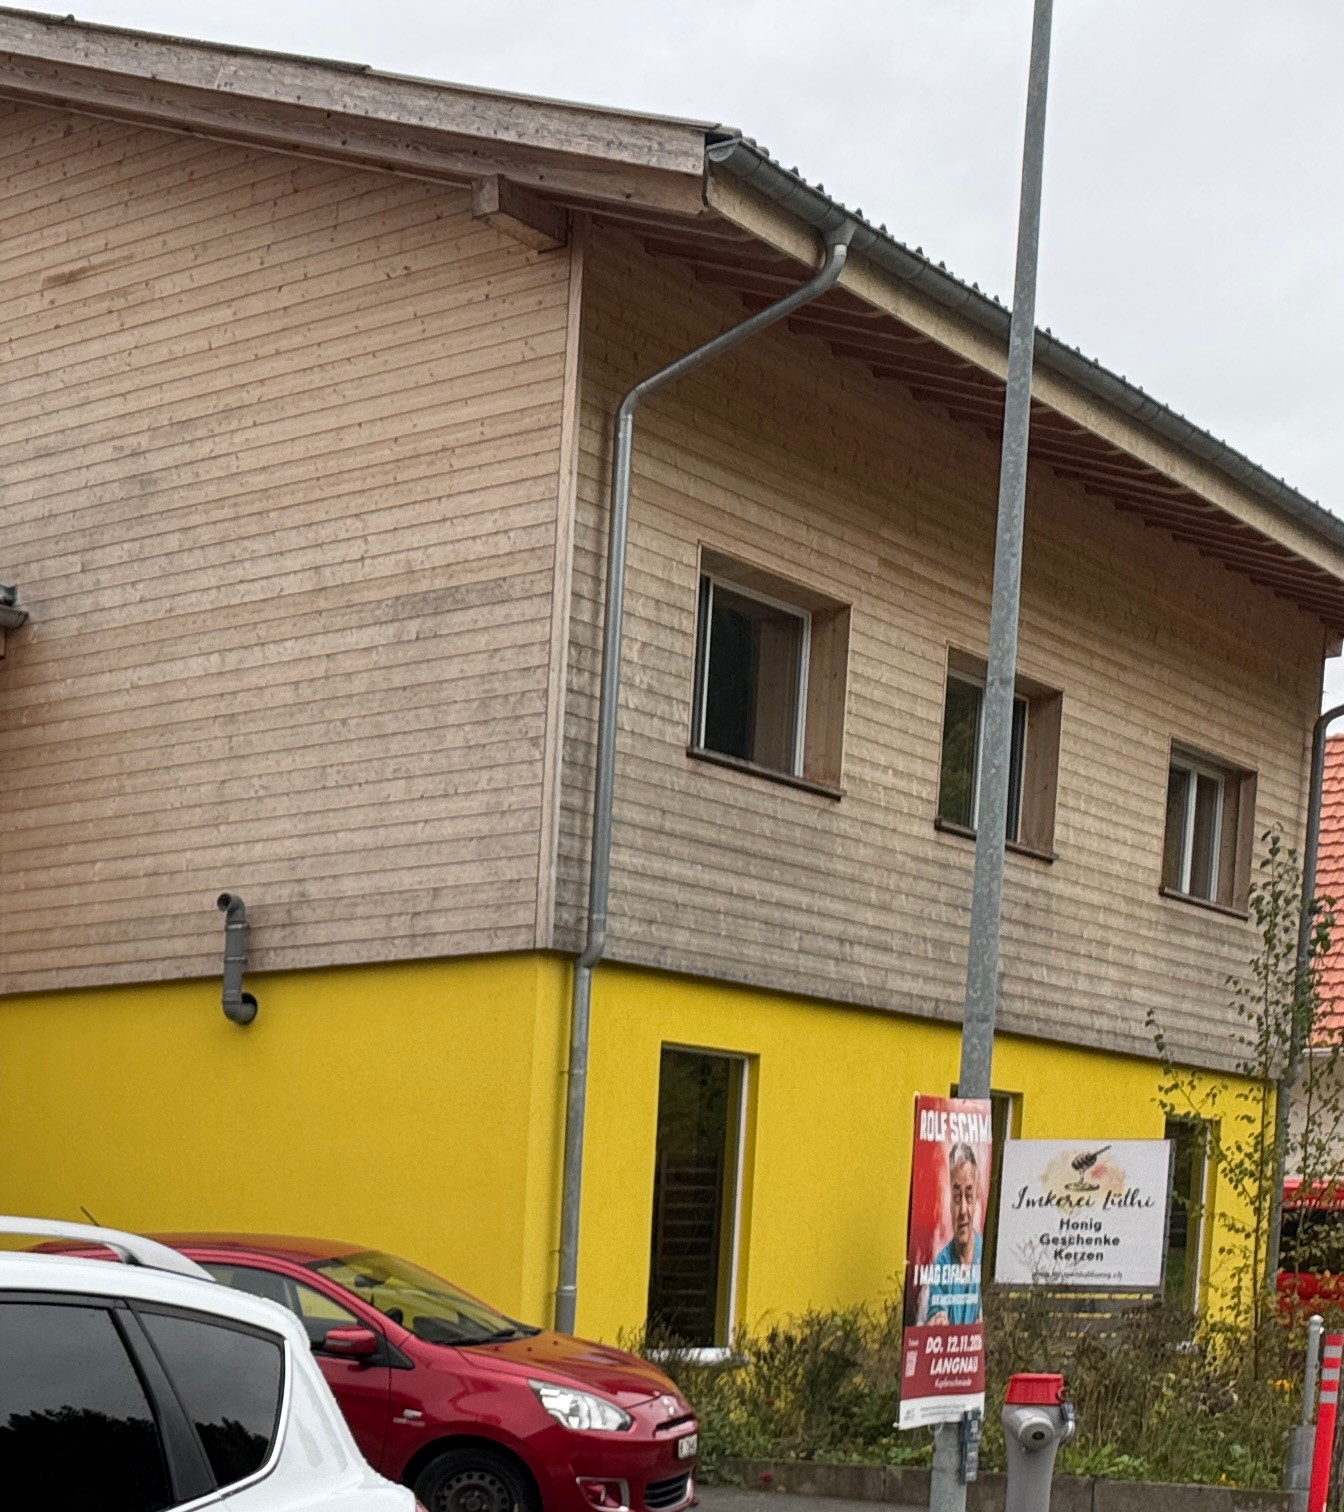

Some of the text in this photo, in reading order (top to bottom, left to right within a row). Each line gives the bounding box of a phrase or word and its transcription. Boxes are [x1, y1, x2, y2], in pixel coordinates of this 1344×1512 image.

[919, 1109, 948, 1142] ROLF
[1011, 1185, 1095, 1210] Imkerei
[1058, 1217, 1103, 1233] Honig
[1038, 1233, 1121, 1247] Geschenke
[1053, 1249, 1105, 1262] Kerzen
[929, 1355, 979, 1376] LANGNAU
